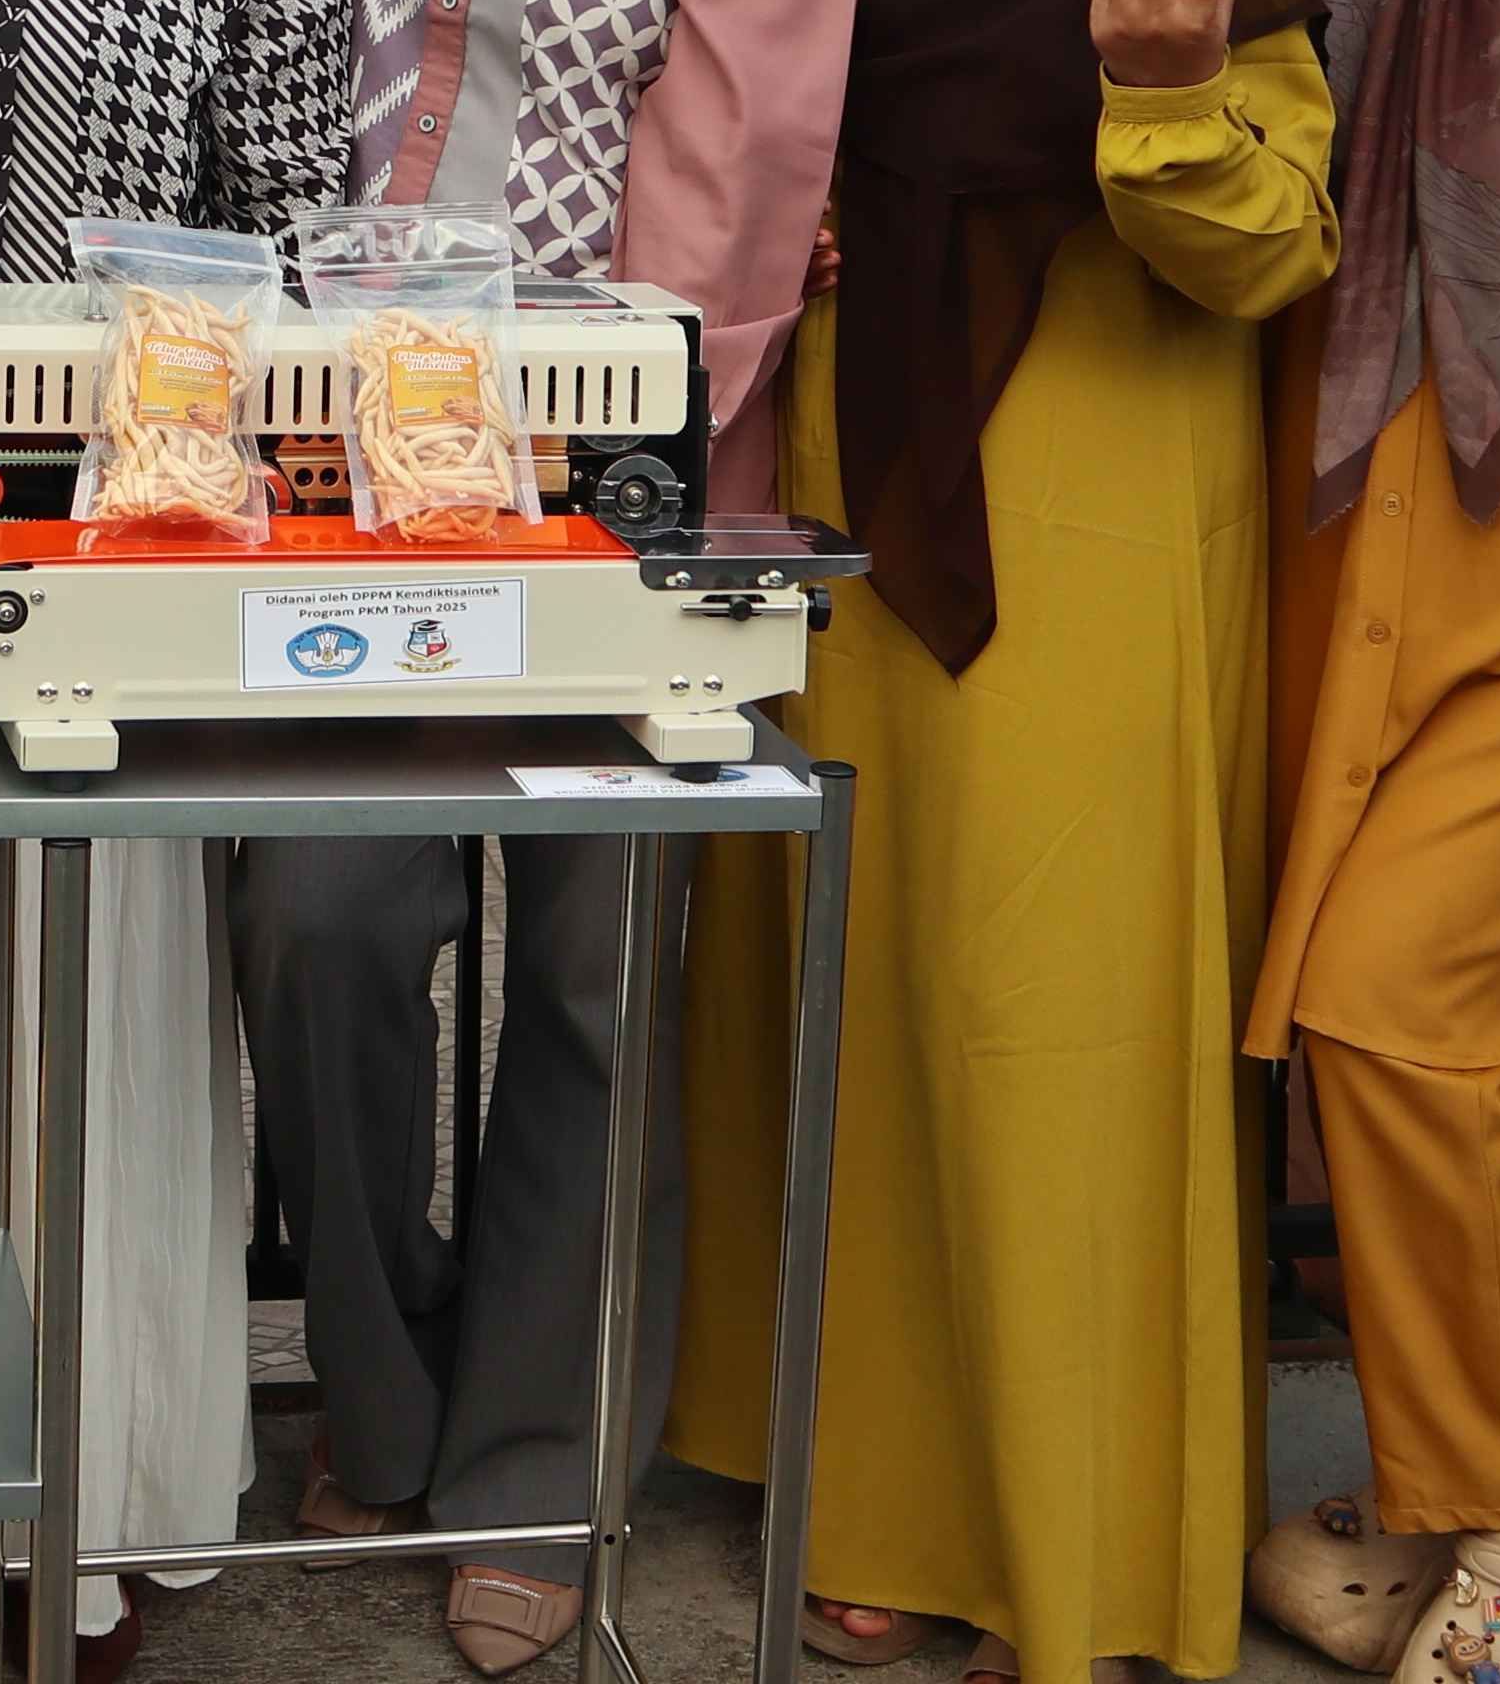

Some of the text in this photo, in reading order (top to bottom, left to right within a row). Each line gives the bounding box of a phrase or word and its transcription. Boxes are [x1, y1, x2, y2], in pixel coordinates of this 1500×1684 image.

[265, 585, 501, 606] Didanai oleh DPPM Kemdiktisaintek
[299, 601, 468, 620] Program PKM Tahun 2025
